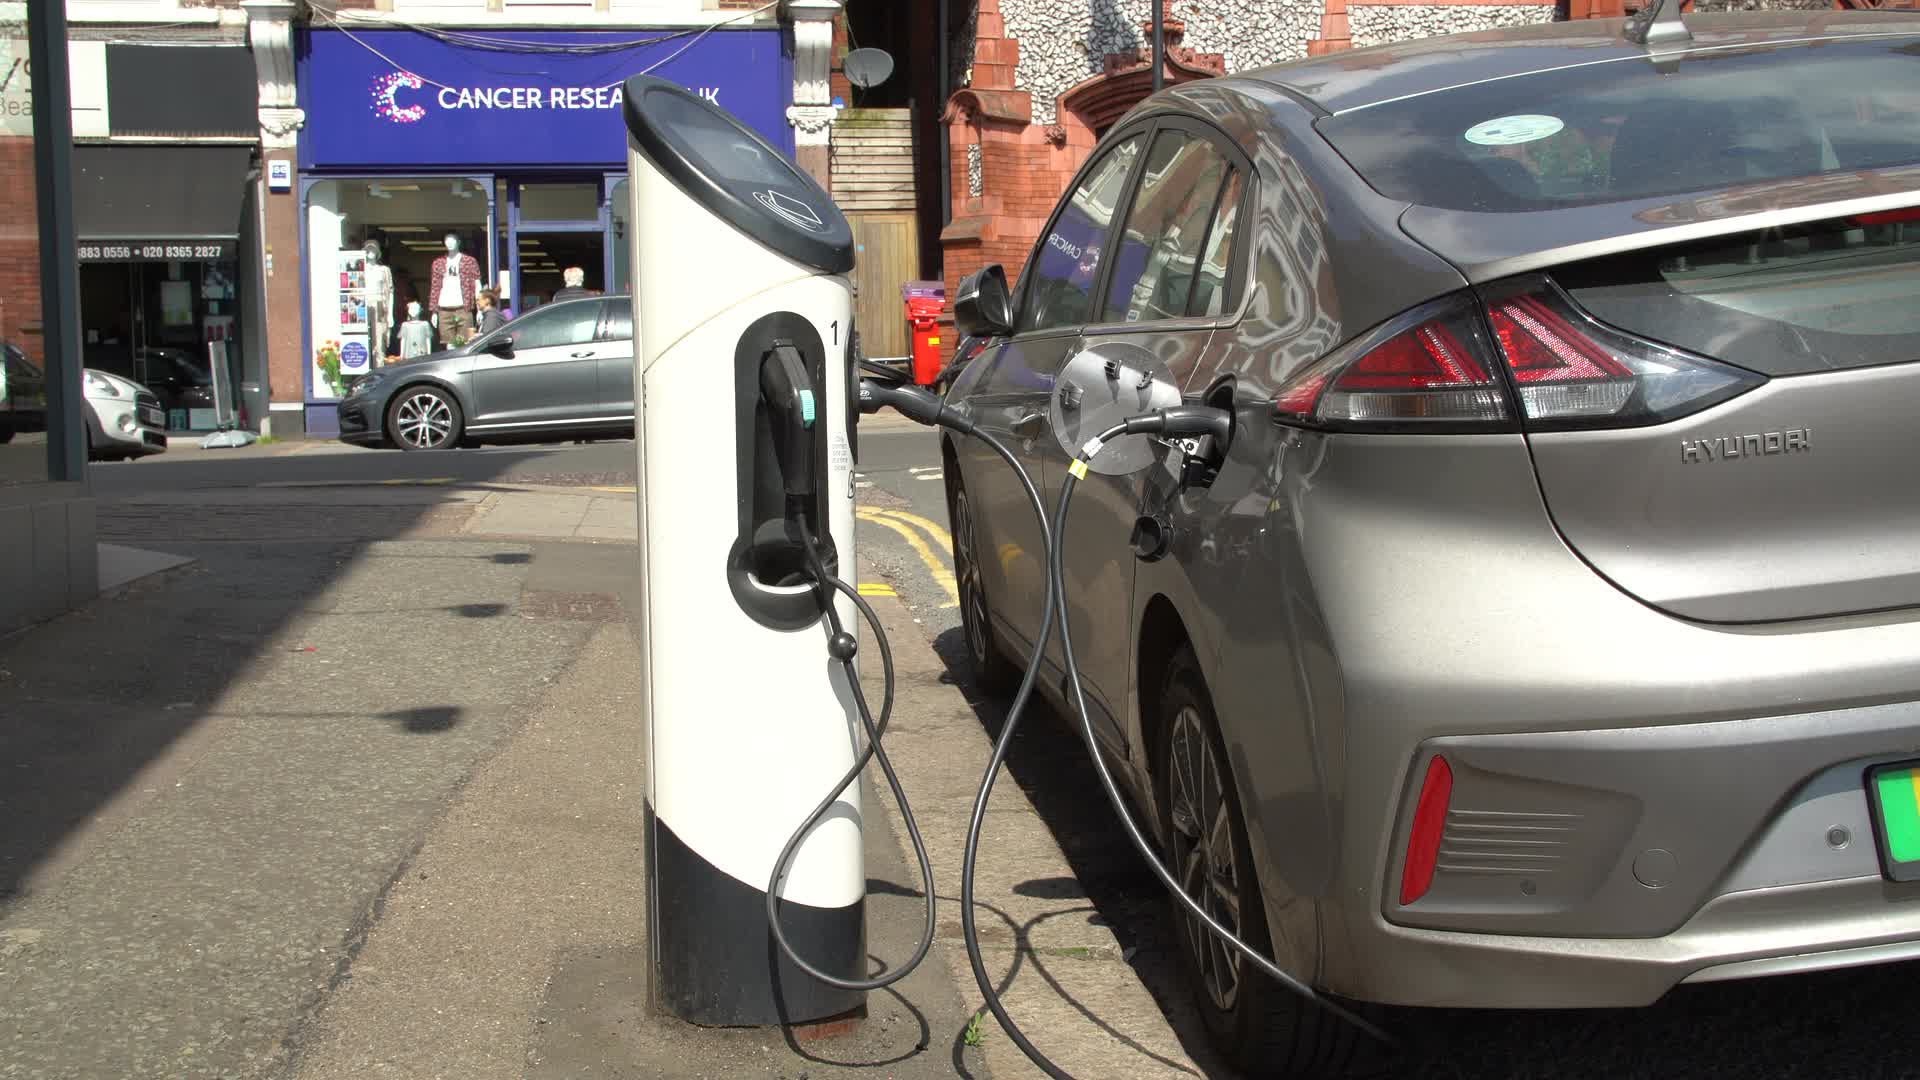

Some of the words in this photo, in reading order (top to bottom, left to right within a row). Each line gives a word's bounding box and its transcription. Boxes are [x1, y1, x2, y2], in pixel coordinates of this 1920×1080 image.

[437, 87, 543, 110] CANCER
[550, 87, 623, 109] RESEA
[78, 246, 101, 259] 883
[103, 246, 130, 259] 0556
[143, 246, 163, 258] 020
[166, 246, 192, 258] 8365
[195, 246, 222, 258] 2827
[830, 319, 839, 346] 1
[1681, 428, 1812, 464] HYUNDAI
